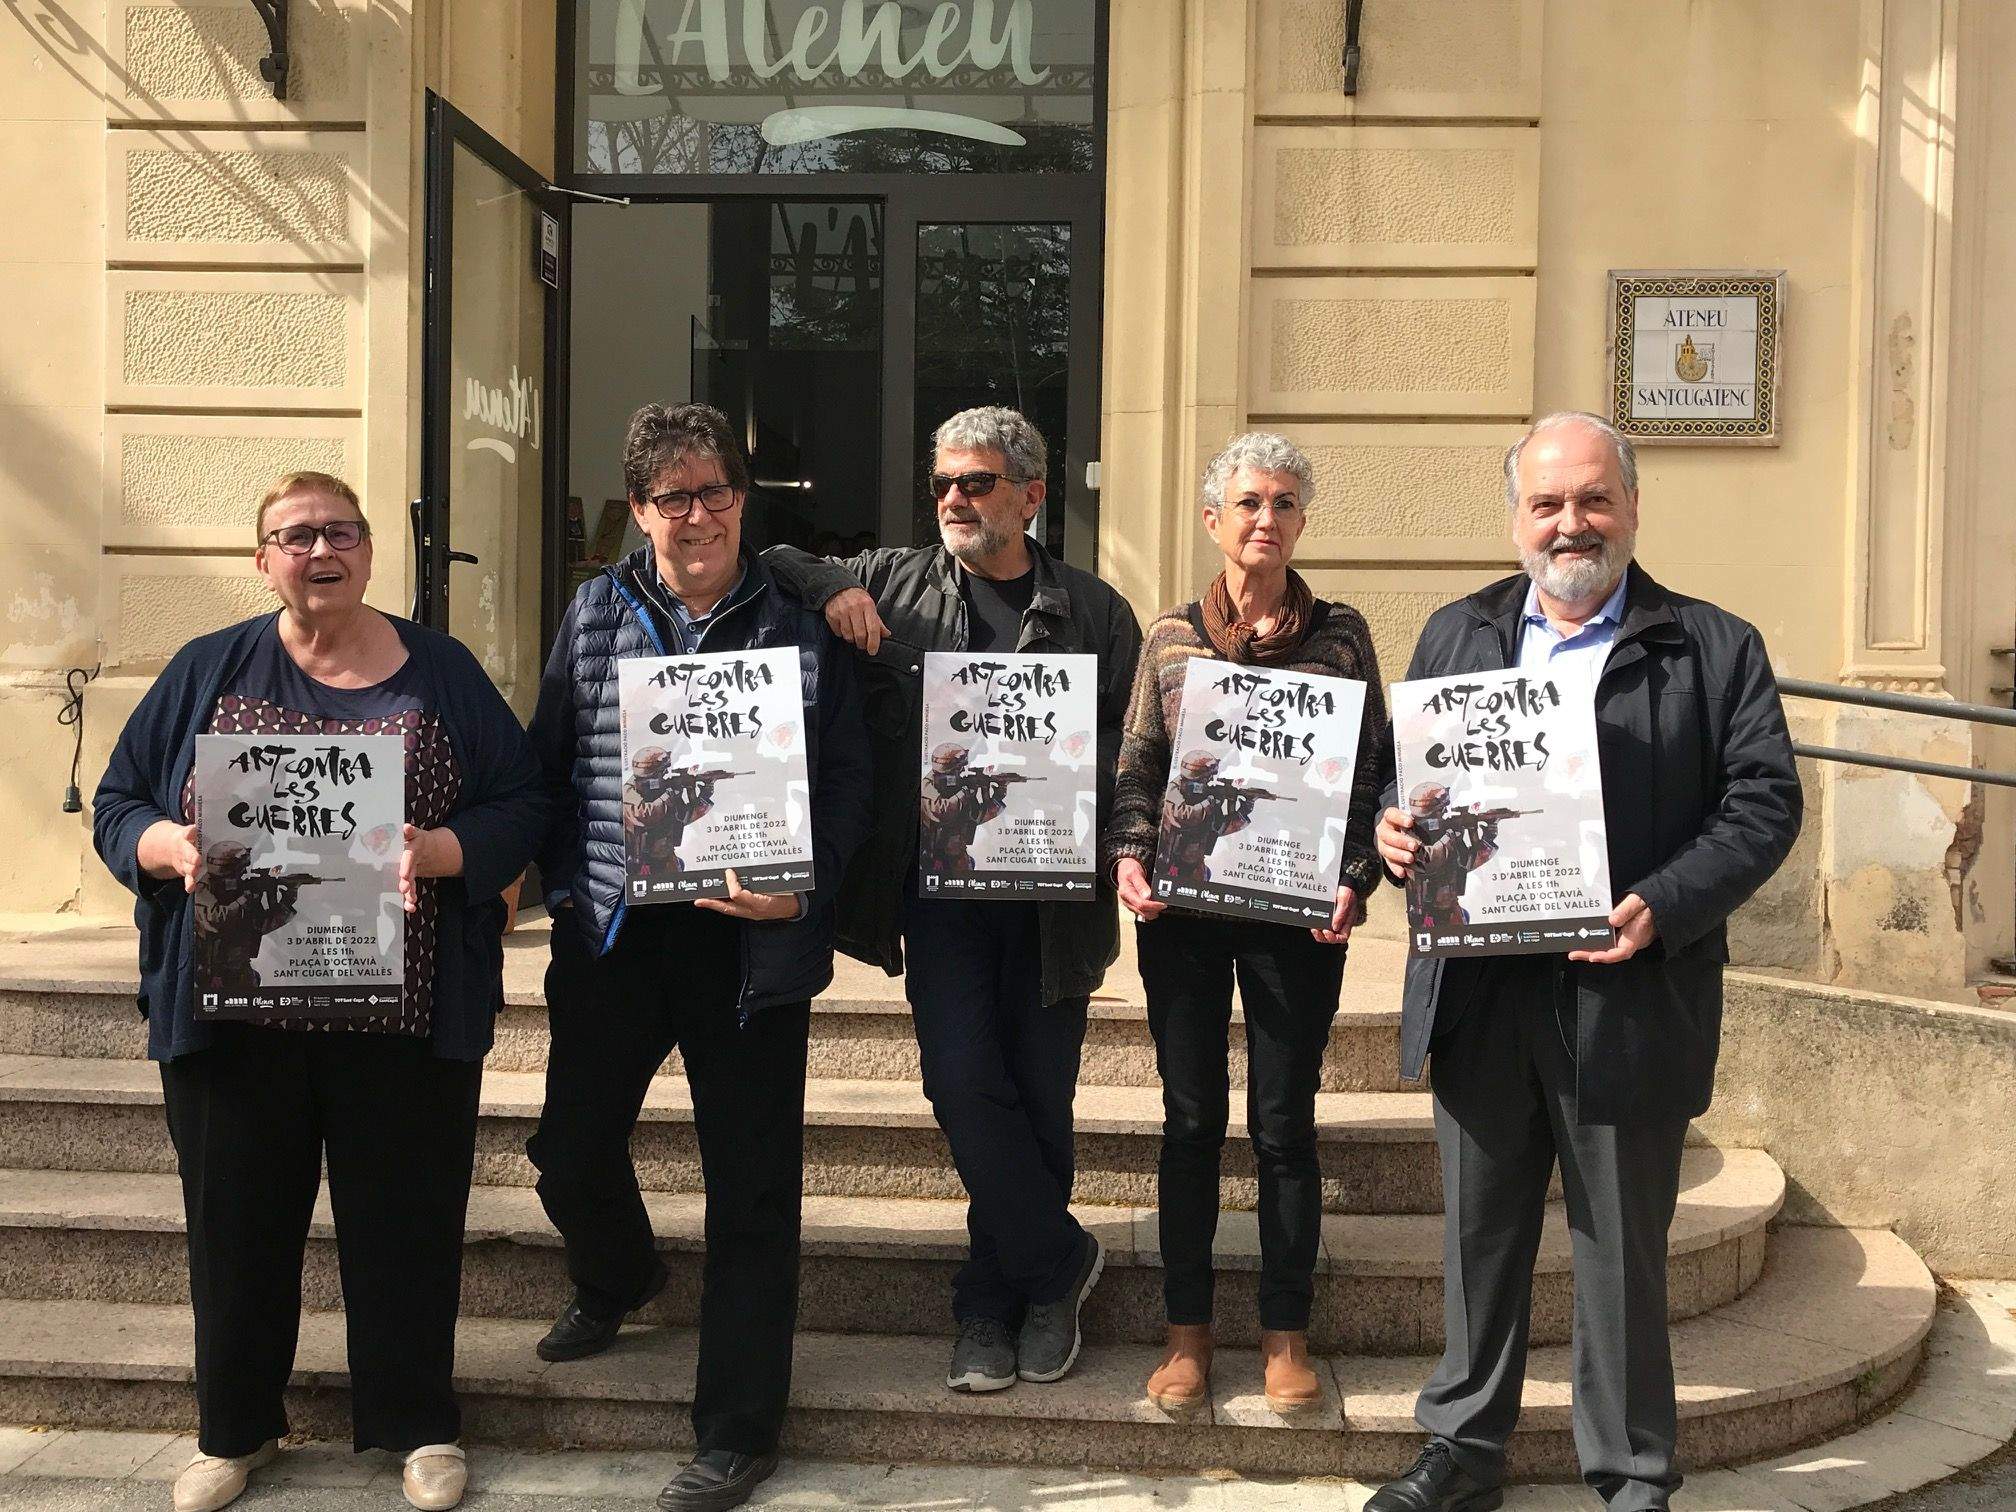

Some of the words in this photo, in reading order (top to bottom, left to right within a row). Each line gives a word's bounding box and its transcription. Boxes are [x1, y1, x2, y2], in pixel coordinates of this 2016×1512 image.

[1664, 310, 1728, 327] ATENEU
[1638, 389, 1750, 406] SANTCUGATENC
[648, 664, 705, 695] ART
[697, 660, 773, 693] CONTRA
[951, 661, 1007, 694] ART
[997, 663, 1071, 697] CONTRA
[1212, 673, 1271, 707] ART
[1259, 682, 1336, 718] CONTRA
[1422, 683, 1484, 721] ART
[1475, 678, 1560, 717] CONTRA
[649, 706, 762, 739] GUERRES
[950, 710, 1057, 744] GUERRES
[1205, 719, 1314, 765] GUERRES
[1426, 732, 1549, 772] GUERRES
[228, 745, 296, 782] ART
[284, 746, 374, 786] CONTRA
[228, 801, 356, 840] GUERRES
[724, 812, 768, 822] DIUMENGE
[715, 824, 747, 832] D'ABRIL
[763, 820, 786, 828] 2022
[710, 843, 737, 852] PLAÇA
[1258, 837, 1301, 849] DIUMENGE
[721, 852, 750, 860] CUGAT
[754, 850, 768, 858] DEL
[771, 846, 802, 856] VALLÈS
[1000, 847, 1025, 855] PLAÇA
[1246, 844, 1278, 855] D'ABRIL
[1294, 852, 1317, 861] 2022
[1057, 856, 1086, 864] VALLÈS
[1267, 857, 1281, 865] LES
[1284, 860, 1296, 868] 11h
[1511, 858, 1559, 868] DIUMENGE
[1238, 863, 1265, 873] PLAÇA
[1501, 871, 1536, 880] D'ABRIL
[1555, 868, 1580, 876] 2022
[1223, 870, 1245, 878] SANT
[1248, 874, 1276, 884] CUGAT
[1279, 879, 1293, 887] DEL
[1296, 882, 1327, 892] VALLÈS
[1482, 906, 1506, 914] SANT
[1510, 904, 1541, 912] CUGAT
[1545, 902, 1561, 910] DEL
[1564, 898, 1600, 908] VALLÈS
[1496, 894, 1527, 903] PLAÇA
[307, 926, 356, 934] DIUMENGE
[290, 959, 320, 968] PLAÇA
[358, 966, 392, 976] VALLÈS
